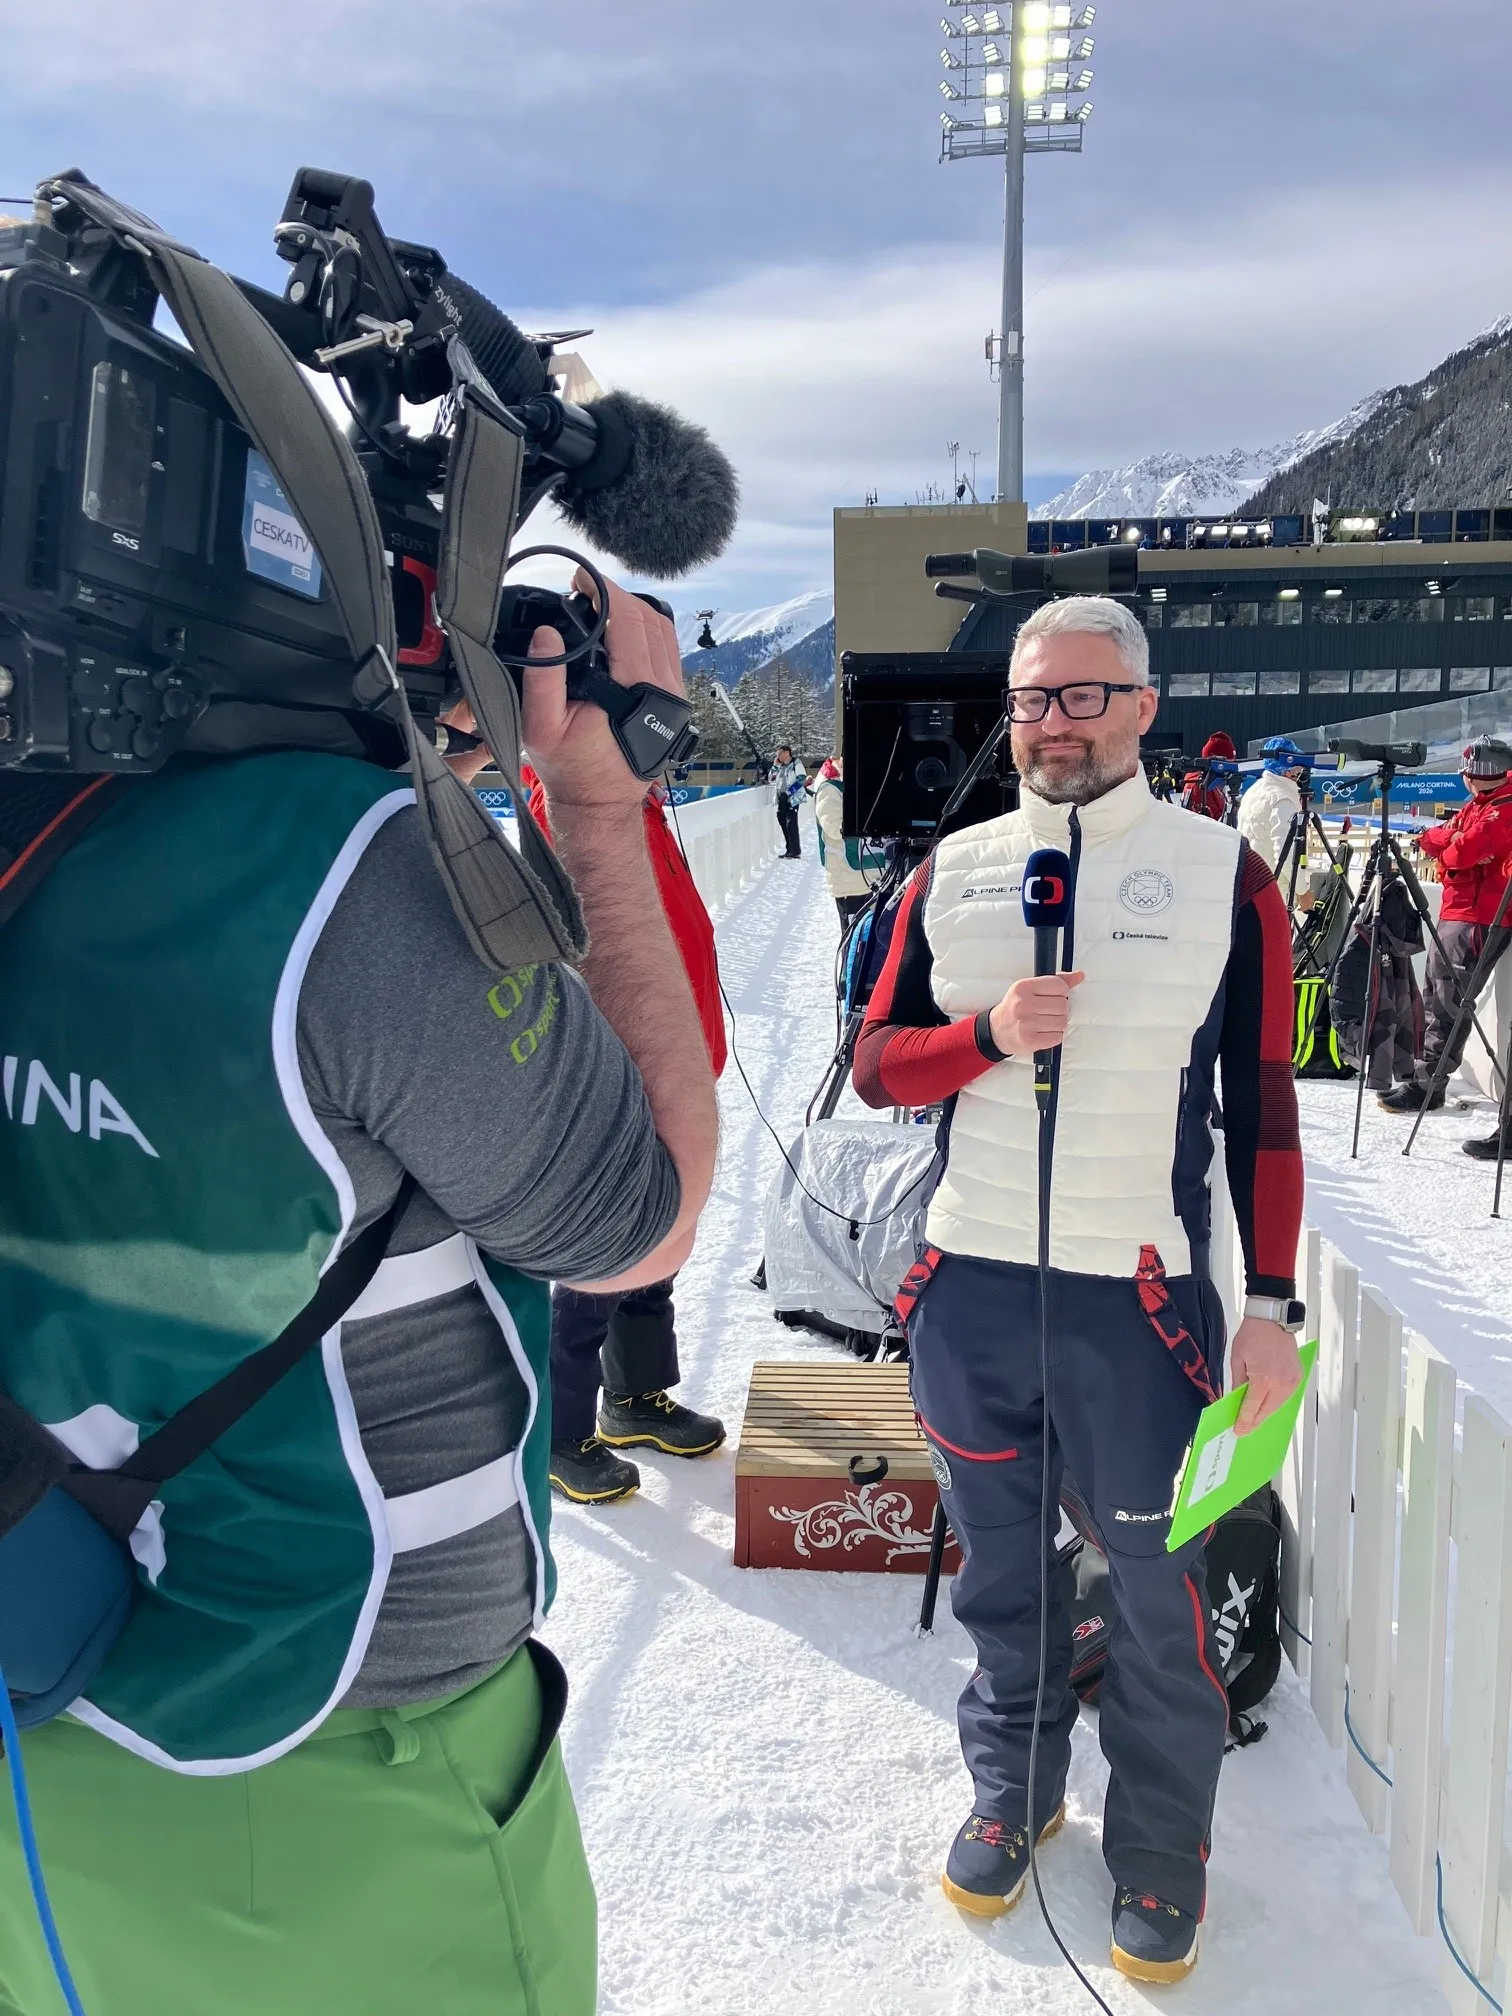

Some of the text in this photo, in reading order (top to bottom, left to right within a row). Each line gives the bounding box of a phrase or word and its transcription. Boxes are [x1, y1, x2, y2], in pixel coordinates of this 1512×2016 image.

[434, 285, 463, 327] zylight
[253, 518, 310, 553] CESKATV
[643, 713, 675, 741] Canon
[1396, 781, 1426, 789] MILANO
[961, 886, 1008, 899] ALPINE
[1121, 876, 1134, 897] CZECH
[1134, 870, 1165, 880] OLYMPIC
[1114, 1510, 1163, 1522] ALPINE
[1211, 1571, 1256, 1669] wix
